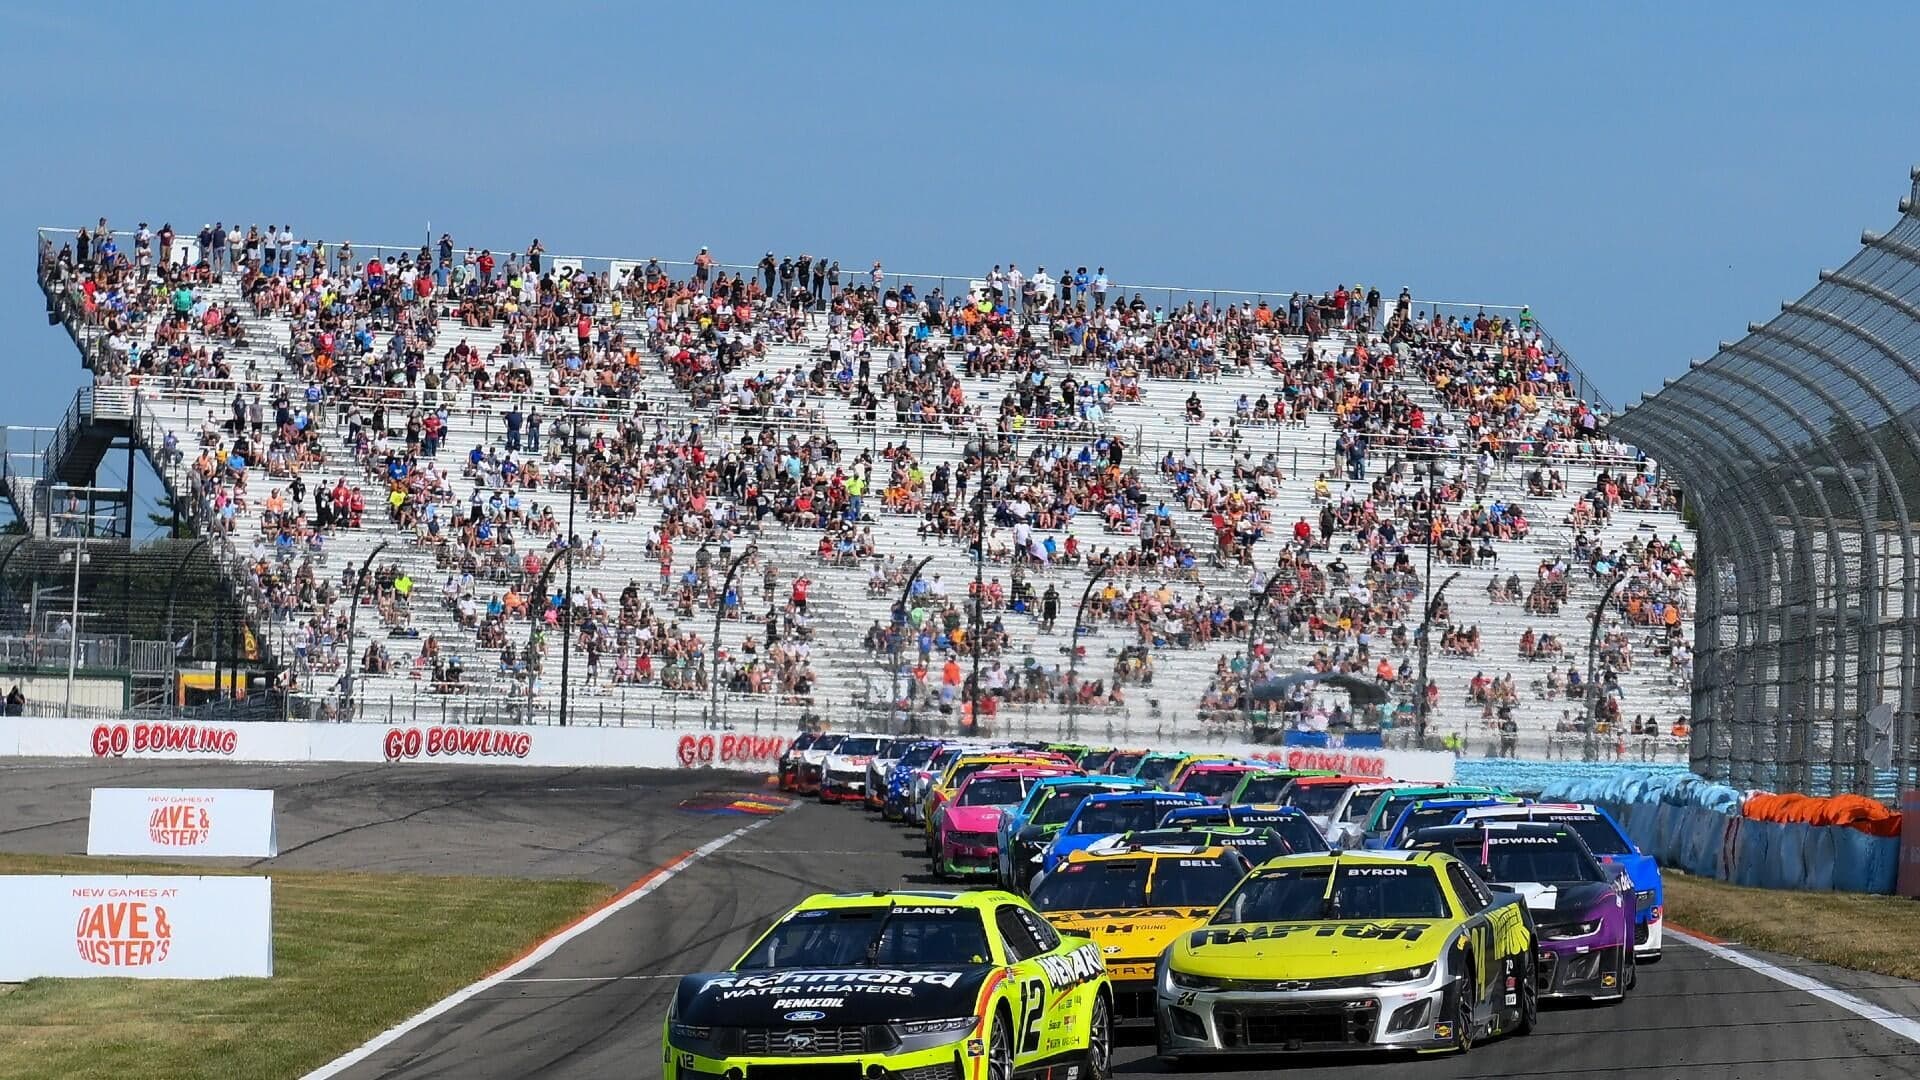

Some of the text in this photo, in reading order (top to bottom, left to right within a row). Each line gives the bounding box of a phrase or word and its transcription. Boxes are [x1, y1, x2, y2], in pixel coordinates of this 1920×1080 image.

[92, 723, 237, 756] GO BOWLING
[385, 727, 531, 759] GO BOWLING
[679, 733, 793, 765] GO BOWL
[150, 806, 210, 829] DAVE &
[150, 828, 209, 846] BUSTER'S
[1488, 837, 1558, 845] BOWMAN
[1348, 868, 1408, 876] BYRON
[72, 888, 178, 897] NEW GAMES AT
[77, 902, 171, 938] DAVE &
[891, 907, 958, 915] BLANEY
[77, 939, 170, 966] BUSTER'S
[723, 985, 913, 999] WATER HEATERS
[1177, 991, 1198, 1006] 24
[774, 998, 845, 1009] PENNZOIL
[1016, 978, 1047, 1054] 12
